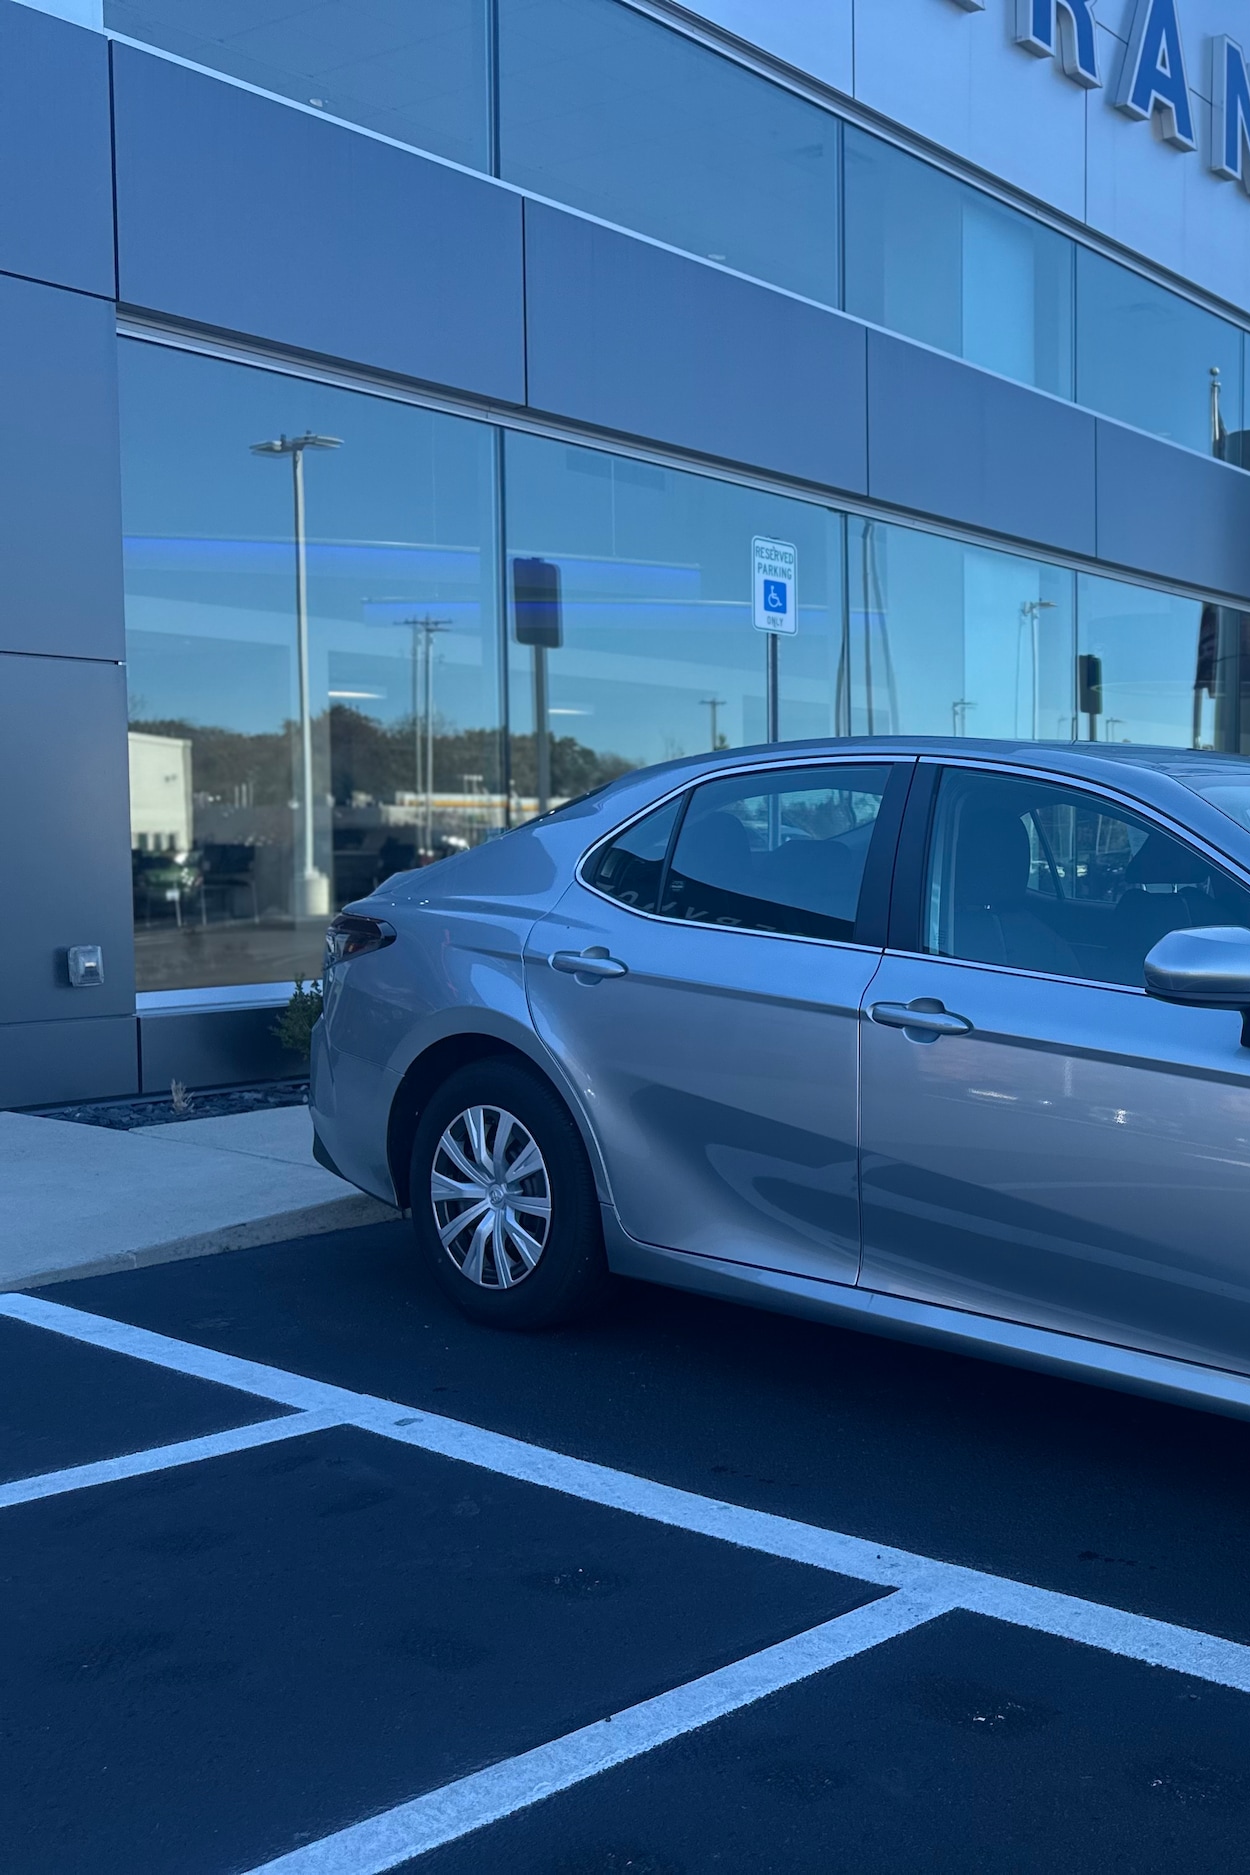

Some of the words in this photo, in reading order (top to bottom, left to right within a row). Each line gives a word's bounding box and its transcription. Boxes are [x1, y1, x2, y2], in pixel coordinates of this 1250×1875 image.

[755, 545, 794, 565] RESERVED
[757, 562, 792, 580] PARKING
[767, 616, 784, 627] ONLY
